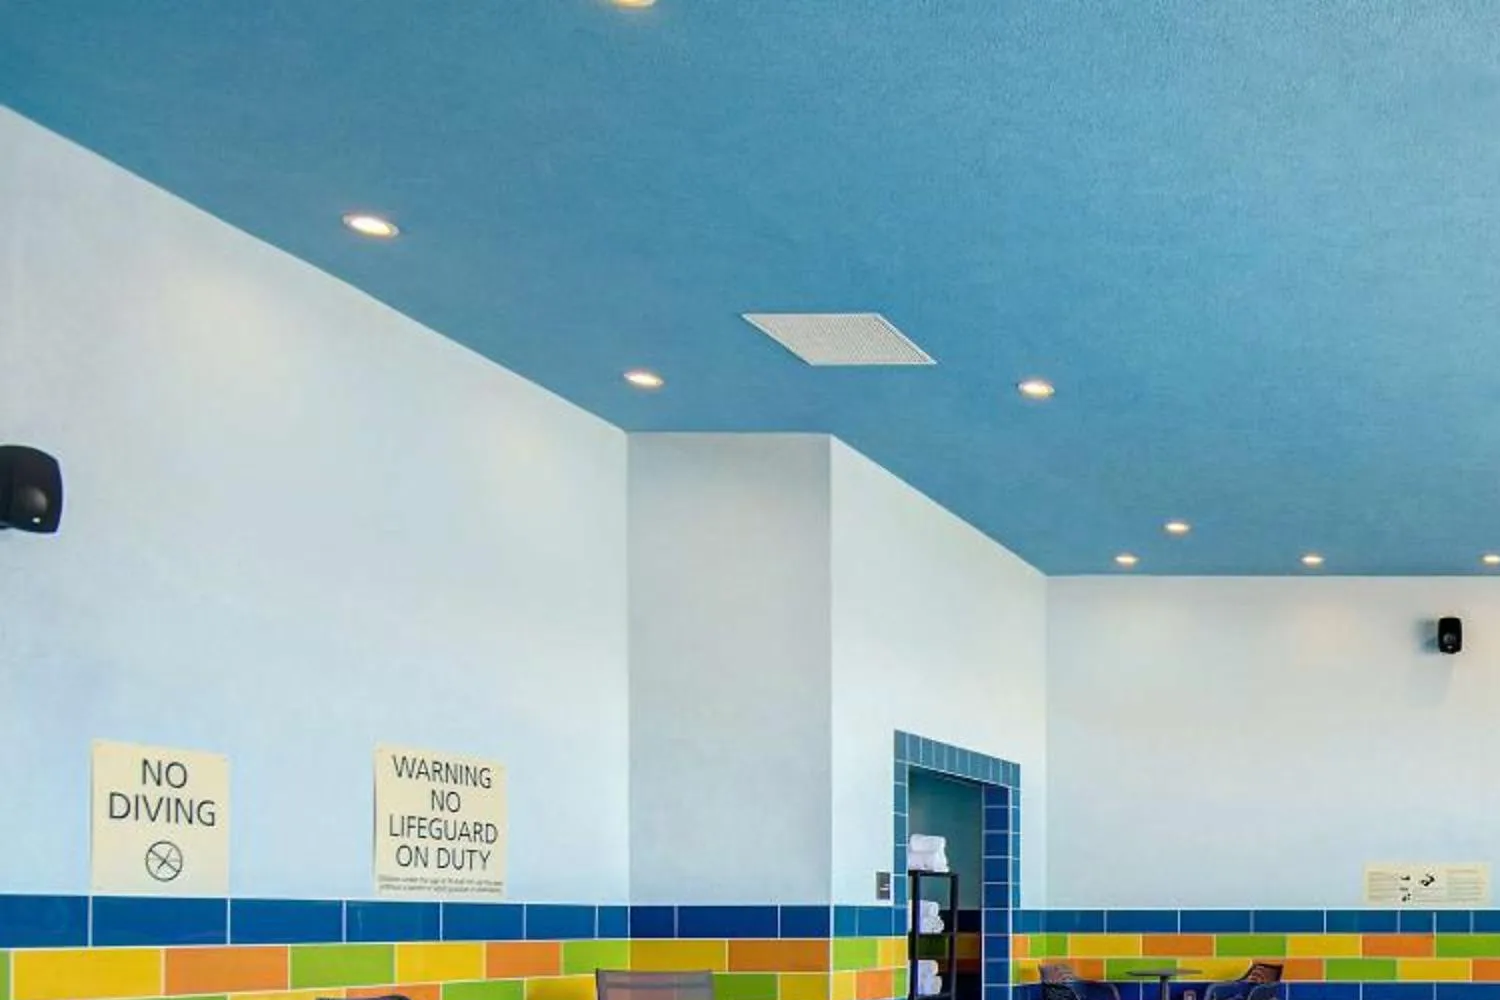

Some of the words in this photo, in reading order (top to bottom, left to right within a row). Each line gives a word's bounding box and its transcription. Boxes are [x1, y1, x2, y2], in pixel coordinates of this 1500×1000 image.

[142, 758, 188, 788] NO
[392, 754, 492, 789] WARNING
[109, 792, 216, 827] DIVING
[431, 789, 461, 813] NO
[389, 814, 499, 844] LIFEGUARD
[395, 845, 429, 868] ON
[437, 847, 491, 871] DUTY
